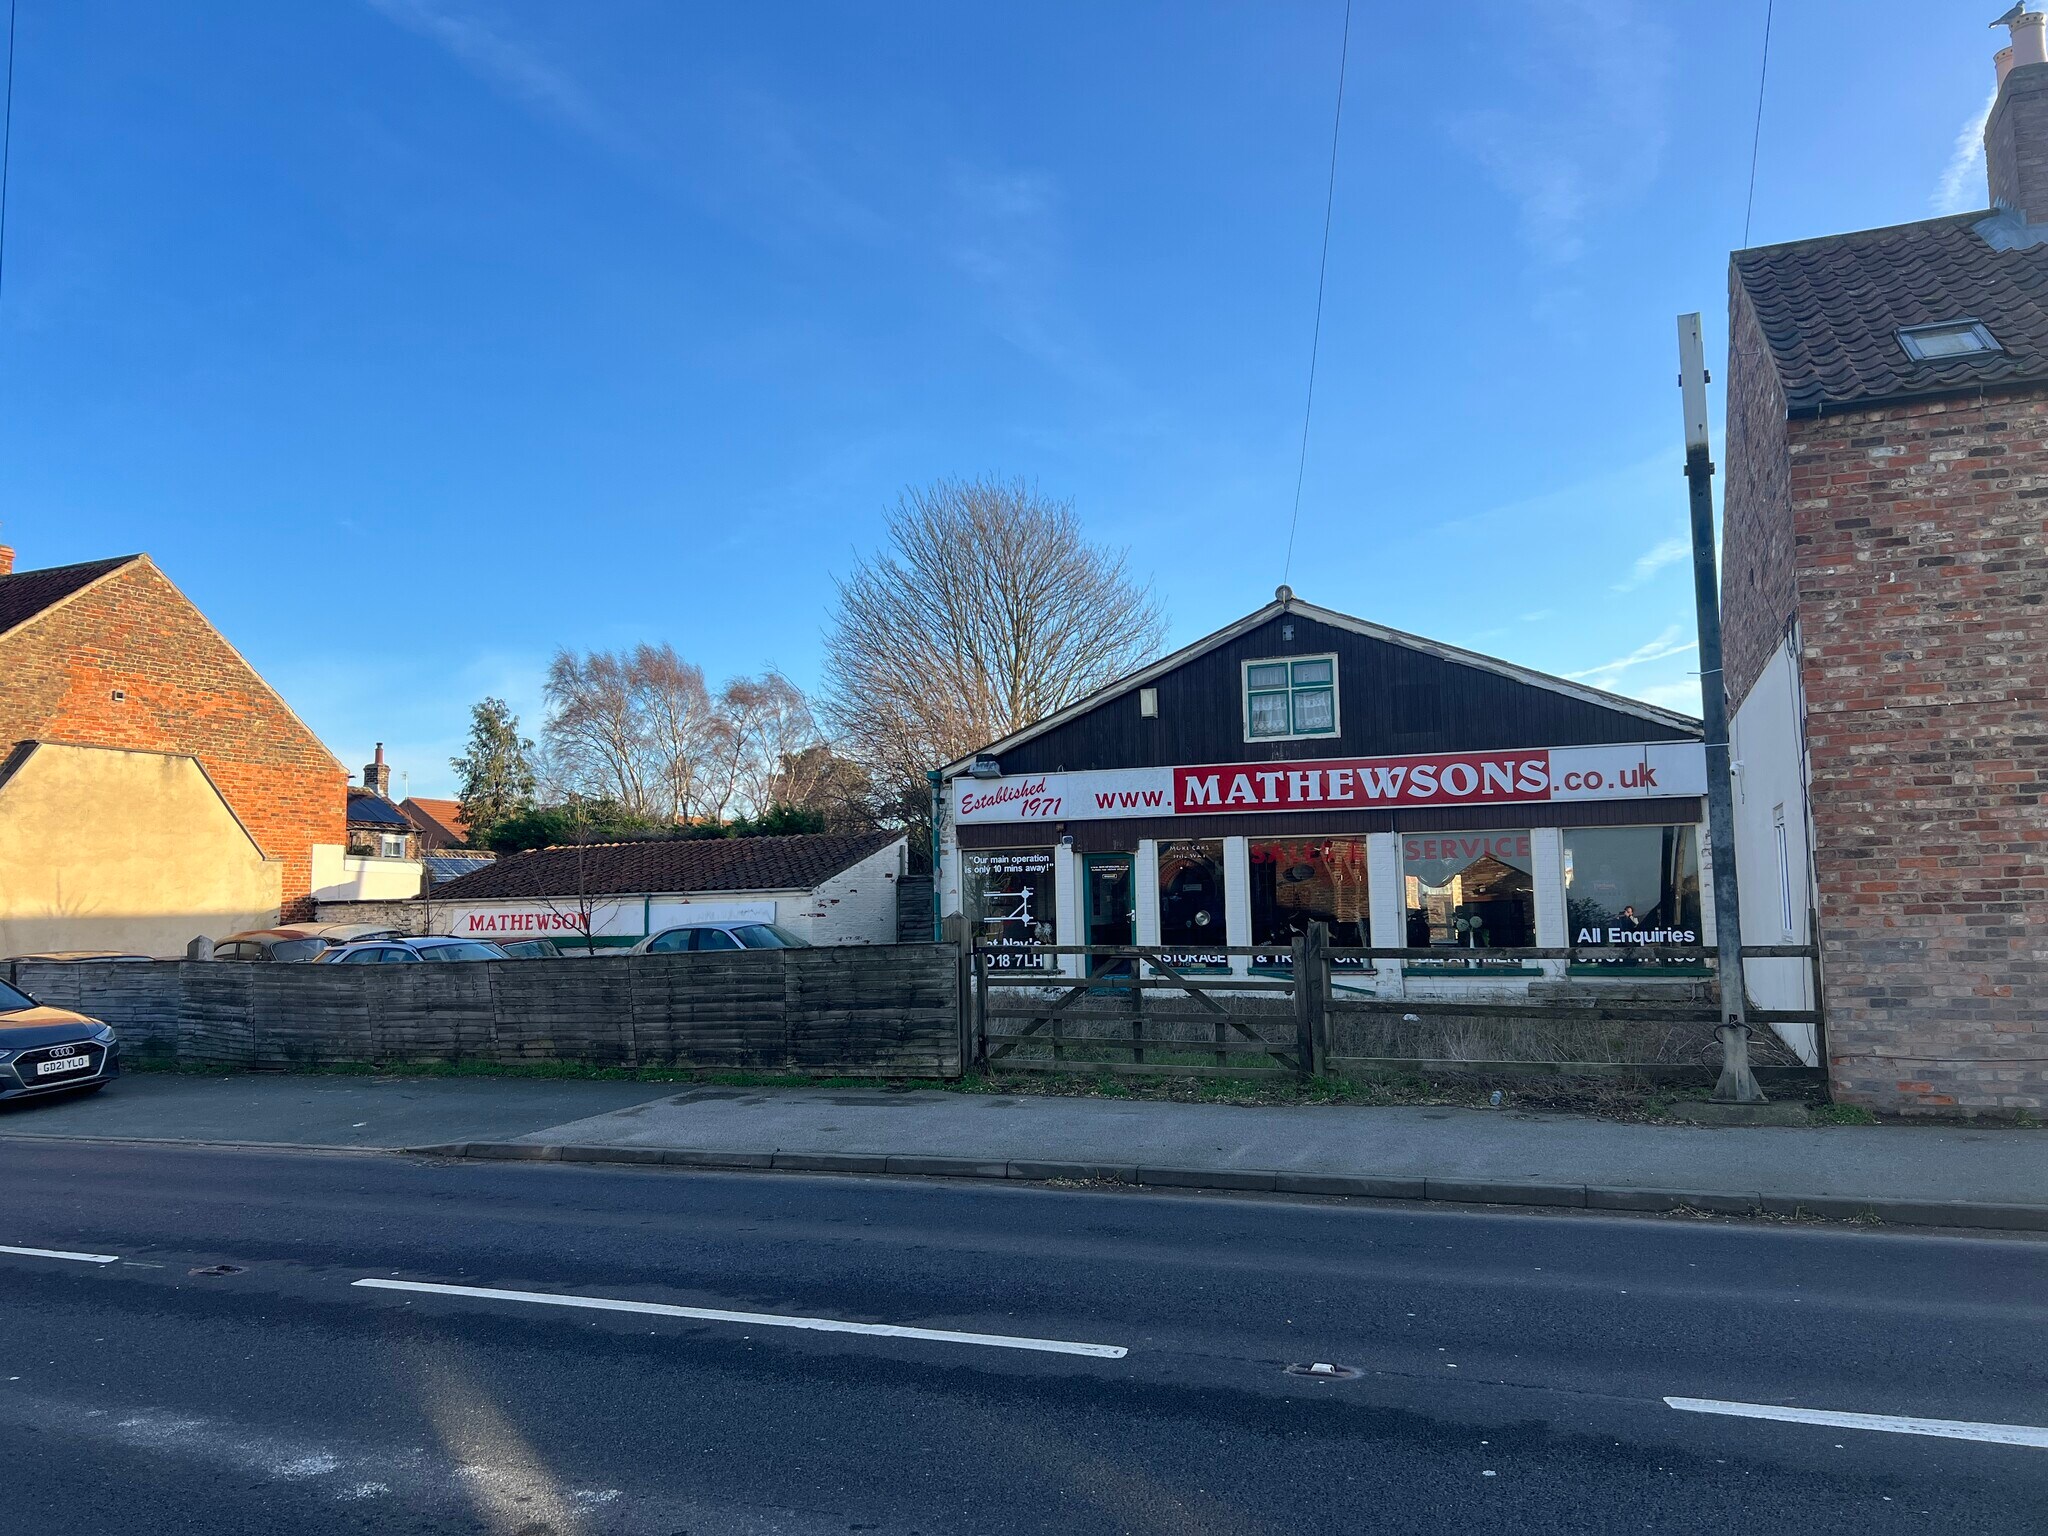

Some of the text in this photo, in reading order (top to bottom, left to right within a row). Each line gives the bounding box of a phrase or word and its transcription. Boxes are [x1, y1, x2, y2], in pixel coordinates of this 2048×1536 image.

[1094, 759, 1657, 809] www. MATHEWSONS .co.uk
[961, 776, 1047, 815] Established
[1021, 797, 1062, 817] 1971
[1404, 837, 1530, 860] SERVICE
[964, 863, 1054, 875] is only 10 mins away!"
[990, 855, 1009, 864] main
[1011, 854, 1049, 864] operation
[468, 911, 591, 932] MATHEWSON
[1577, 927, 1696, 947] All Enquiries
[1014, 954, 1043, 967] 7LH
[43, 1057, 84, 1073] GD21 YLO
